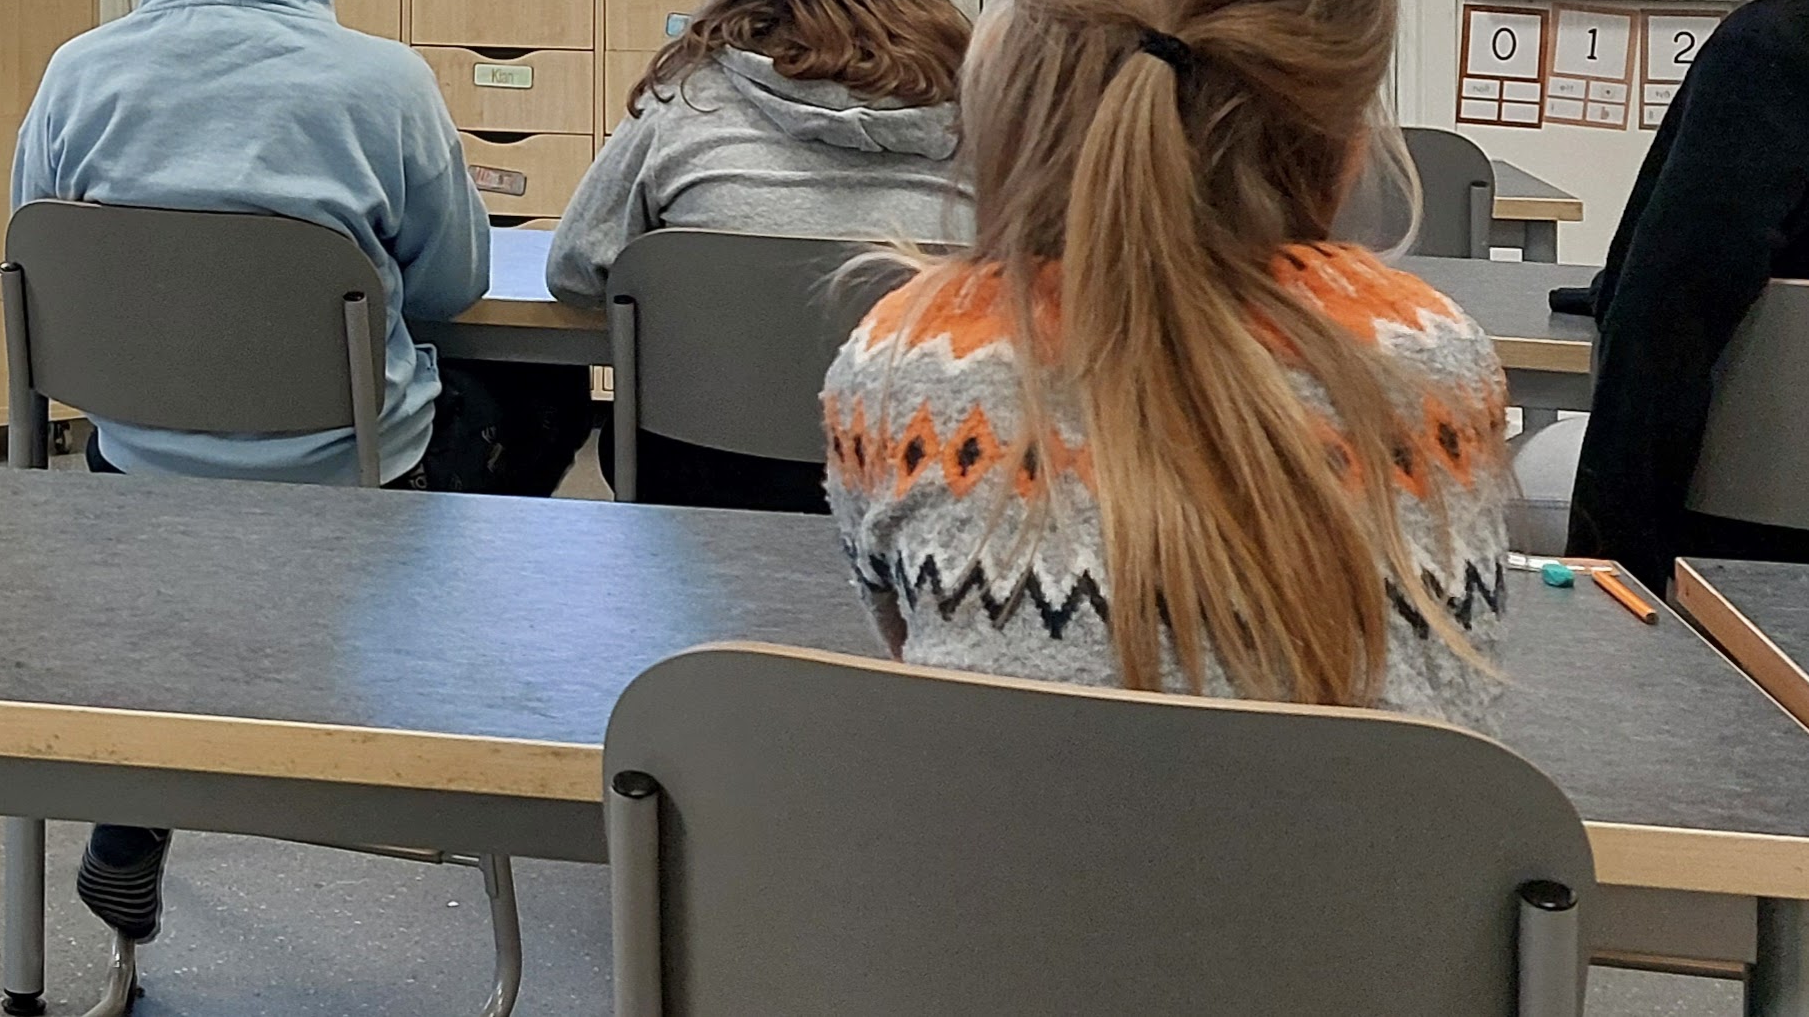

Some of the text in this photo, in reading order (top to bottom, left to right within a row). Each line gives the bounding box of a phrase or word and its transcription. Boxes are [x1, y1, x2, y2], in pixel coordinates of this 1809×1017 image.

[1491, 27, 1518, 61] 0
[1586, 27, 1599, 61] 1
[1673, 31, 1697, 65] 2
